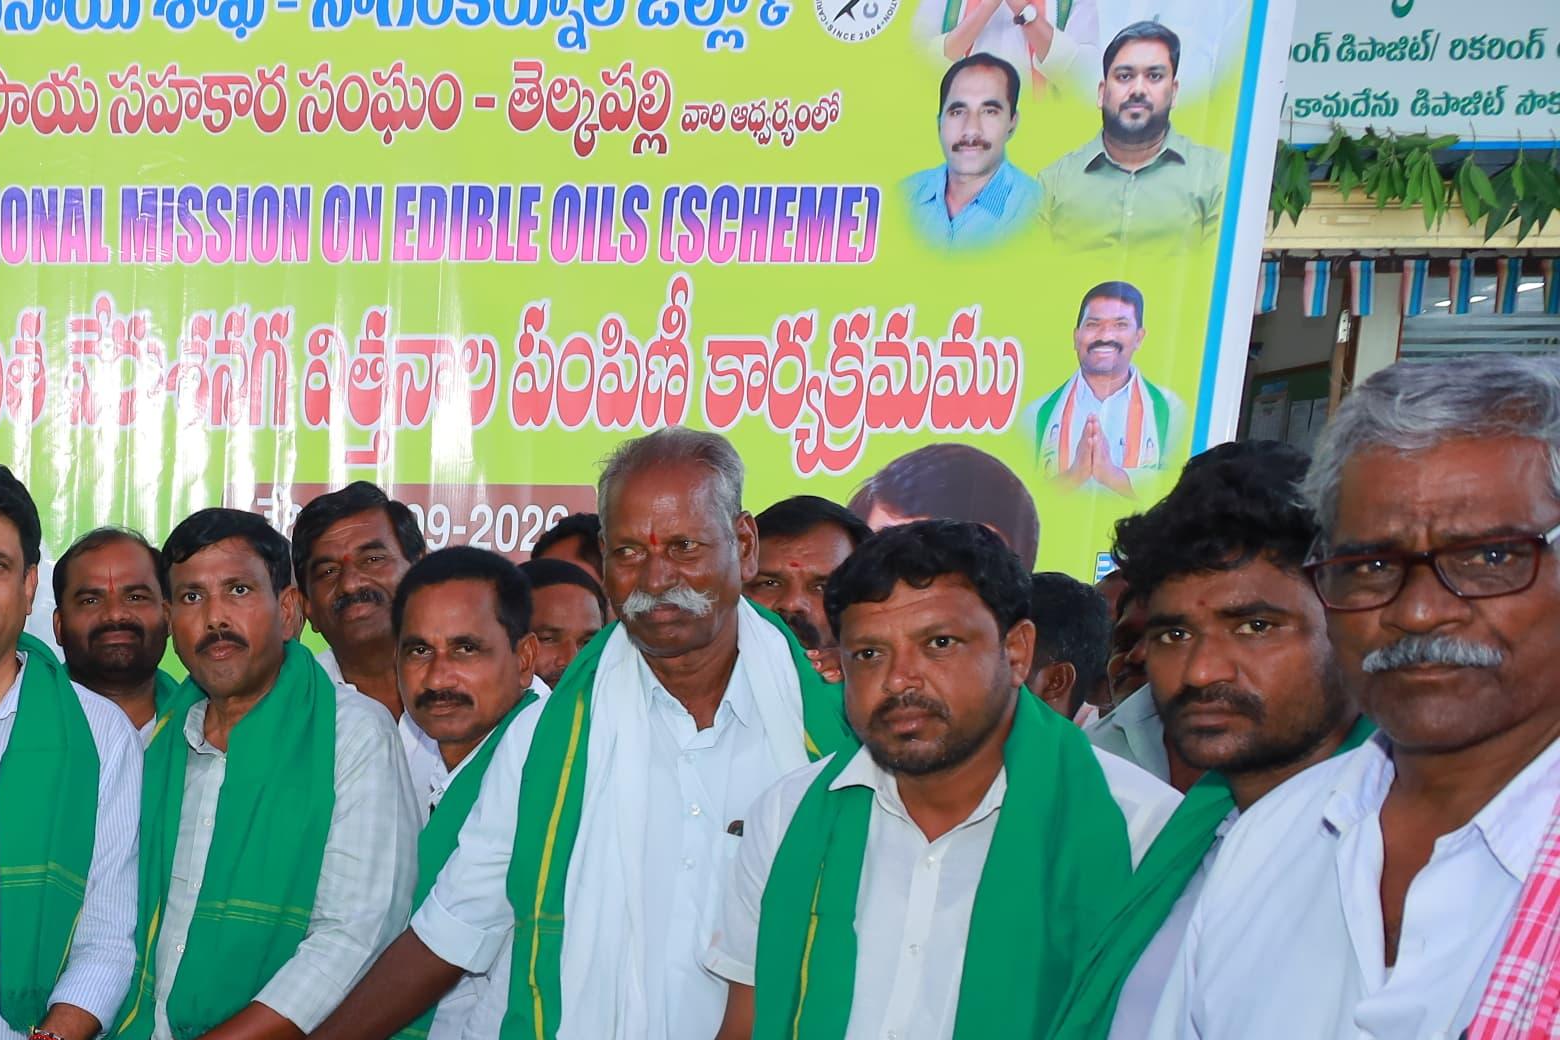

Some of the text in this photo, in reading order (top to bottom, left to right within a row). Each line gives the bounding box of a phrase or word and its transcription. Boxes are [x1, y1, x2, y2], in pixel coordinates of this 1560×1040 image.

[827, 24, 882, 41] SINCE 2004
[1289, 32, 1333, 63] ంగ్
[1448, 28, 1548, 61] రికరింగ్
[109, 64, 286, 136] సహకార
[298, 61, 462, 145] సంఘం
[474, 95, 496, 110] -
[508, 60, 672, 158] తెల్కపల్లి
[681, 103, 727, 132] వారి
[730, 91, 841, 147] ఆధ్వర్యంలో
[1410, 85, 1509, 117] డిపాజిట్
[120, 185, 311, 264] MISSION
[320, 185, 382, 263] ON
[392, 185, 541, 263] EDIBLE
[550, 185, 650, 264] OILS
[661, 185, 880, 263] (SCHEME)
[511, 276, 690, 428] పంపిణీ
[705, 309, 1021, 475] కార్యక్రమము
